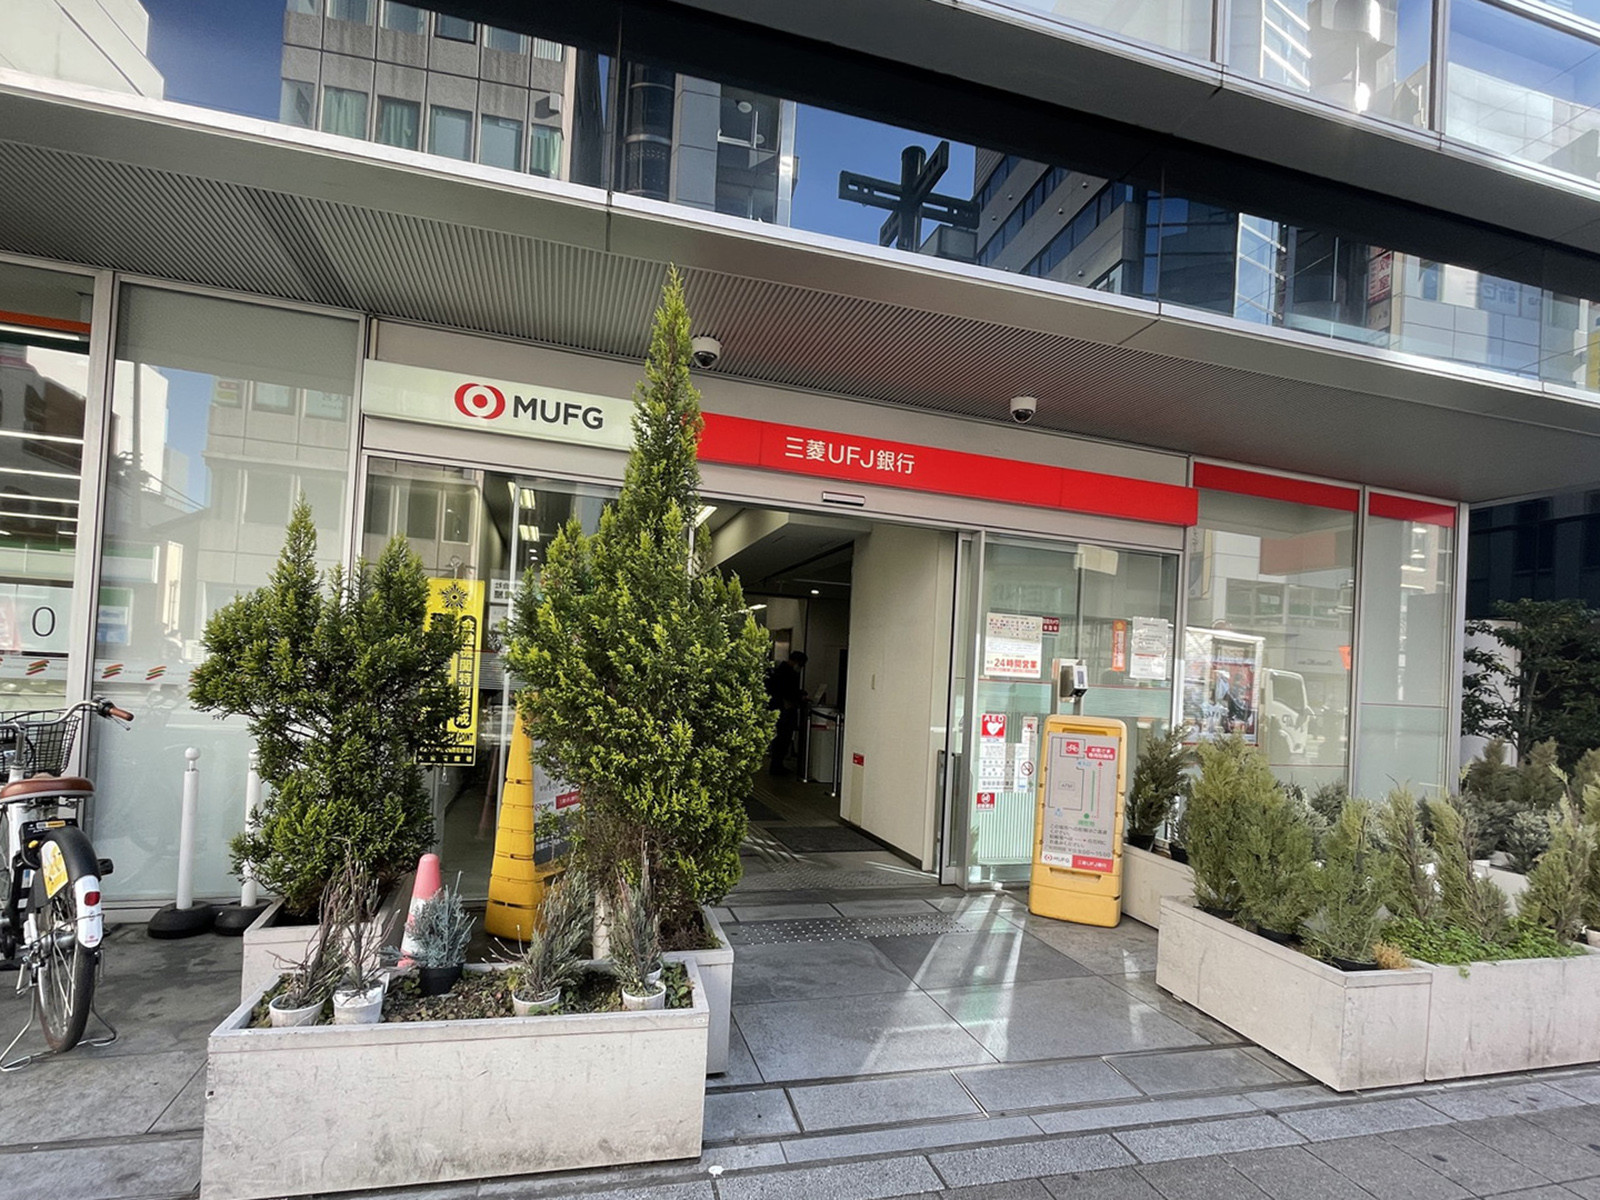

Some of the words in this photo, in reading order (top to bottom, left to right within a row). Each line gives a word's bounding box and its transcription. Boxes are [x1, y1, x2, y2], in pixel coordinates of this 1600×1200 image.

[512, 395, 603, 430] MUFG
[785, 436, 915, 475] 三菱UFJ銀行
[994, 658, 1037, 669] 24時間営業
